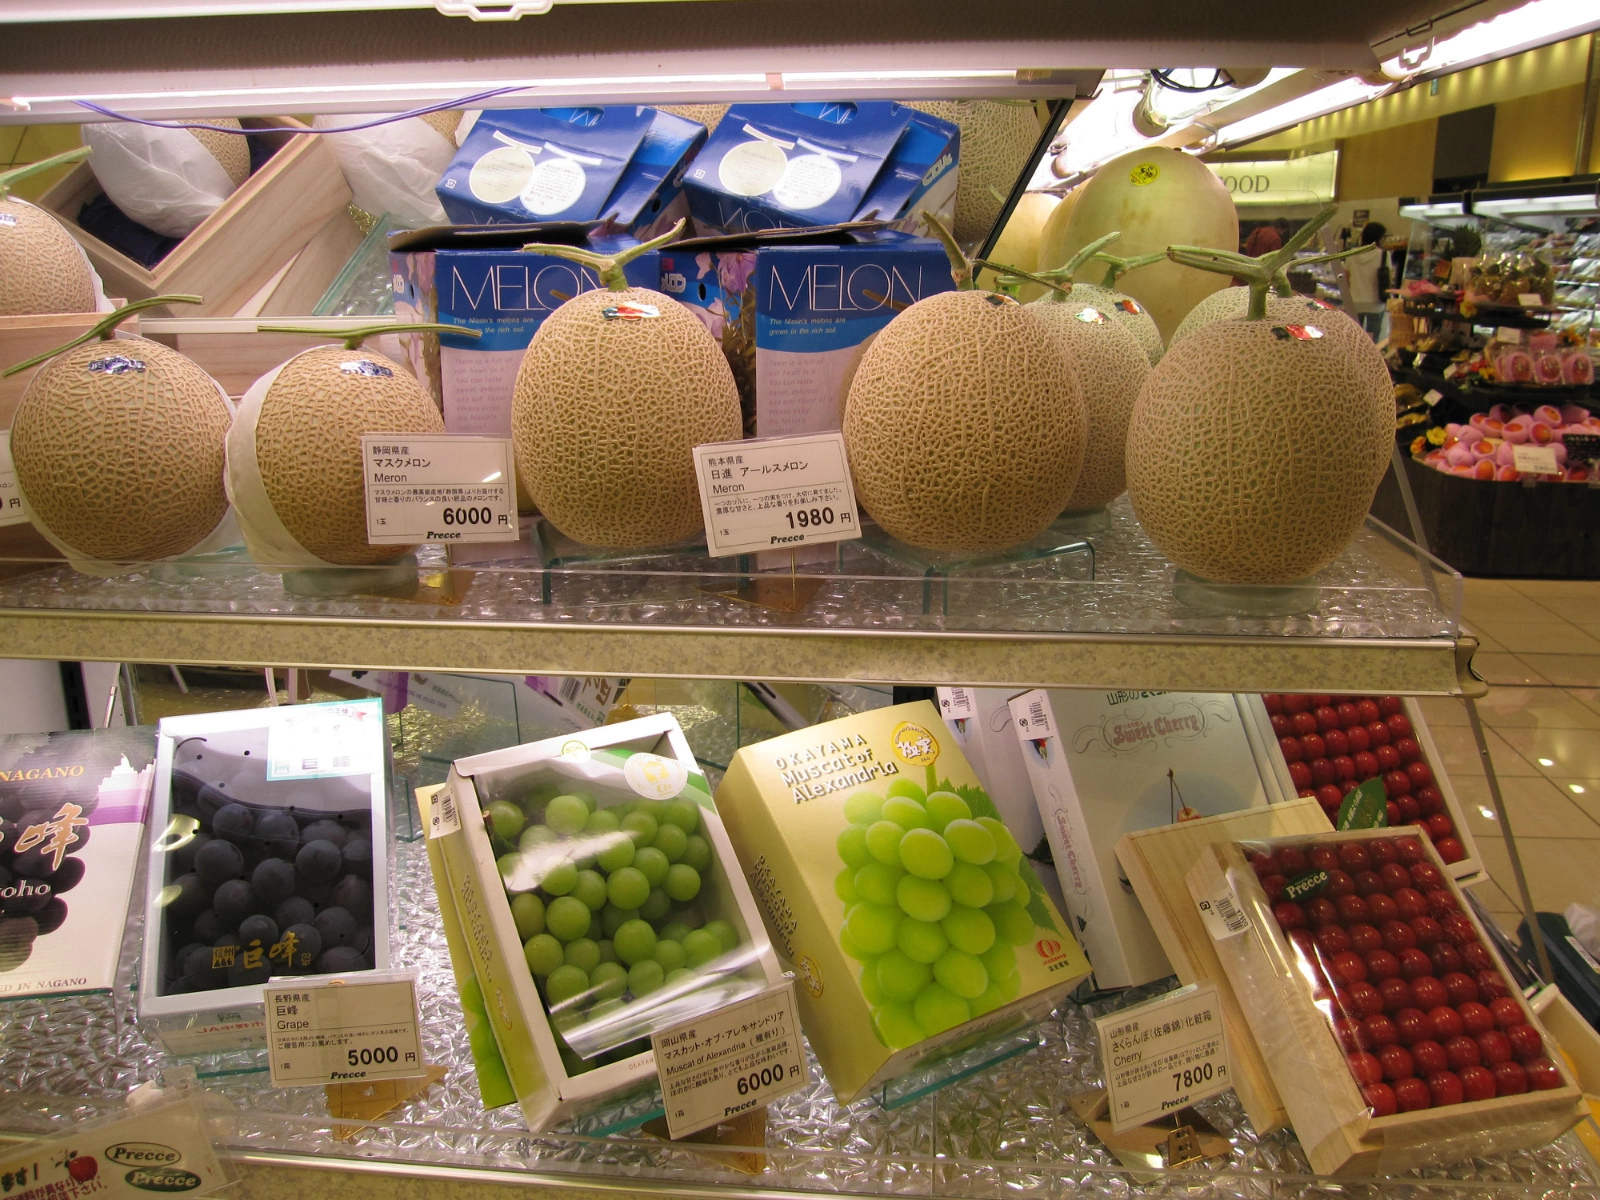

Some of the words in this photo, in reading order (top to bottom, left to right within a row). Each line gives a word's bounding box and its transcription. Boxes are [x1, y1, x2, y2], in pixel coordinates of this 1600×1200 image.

[768, 263, 922, 311] MELON
[784, 317, 808, 325] Nissin's
[372, 446, 410, 455] 静岡県産
[373, 458, 431, 468] マスクメロン
[708, 455, 744, 467] 熊本県産
[374, 473, 407, 483] Meron
[711, 468, 733, 480] 日進
[739, 462, 809, 477] アールスメロン
[712, 483, 745, 494] Meron
[9, 497, 21, 509] 円
[443, 507, 492, 525] 6000
[498, 514, 508, 525] 円
[785, 506, 835, 529] 1980
[840, 512, 852, 524] 円
[426, 531, 461, 540] Precce
[770, 534, 805, 544] Precce
[1112, 722, 1155, 746] Sweet
[1154, 714, 1200, 736] Cherry
[774, 734, 868, 771] OKAYAMA
[0, 765, 85, 782] NAGANO
[779, 755, 856, 788] Muscat
[856, 748, 874, 764] of
[791, 761, 899, 805] Alexandria
[0, 802, 89, 871] 峰
[0, 880, 51, 898] oho
[1285, 870, 1328, 899] Precce
[243, 931, 300, 970] 巨峰
[17, 982, 31, 991] IN
[36, 977, 88, 989] NAGANO
[274, 993, 311, 1004] 長野県産
[276, 1005, 299, 1016] 巨峰
[277, 1019, 309, 1031] Grape
[1109, 1021, 1140, 1040] 山形県産
[661, 1029, 698, 1049] 岡山県産
[664, 1010, 784, 1060] マスカット・オブ・アレキサンドリア
[347, 1045, 399, 1066] 5000
[405, 1051, 416, 1063] 円
[628, 1057, 655, 1070] OKAYAM
[666, 1060, 695, 1076] Muscat
[696, 1056, 705, 1065] of
[705, 1042, 746, 1062] Alexandria
[1113, 1050, 1143, 1068] Cherry
[280, 1062, 291, 1070] 1箱
[330, 1070, 367, 1080] Precce
[737, 1063, 784, 1095] 6000
[789, 1064, 800, 1078] 円
[1172, 1062, 1213, 1092] 7800
[1217, 1065, 1227, 1078] 円
[724, 1099, 758, 1117] Precce
[1161, 1094, 1190, 1111] Precce
[674, 1109, 685, 1118] 1箱
[113, 1147, 176, 1162] Precce
[131, 1172, 197, 1187] Precce
